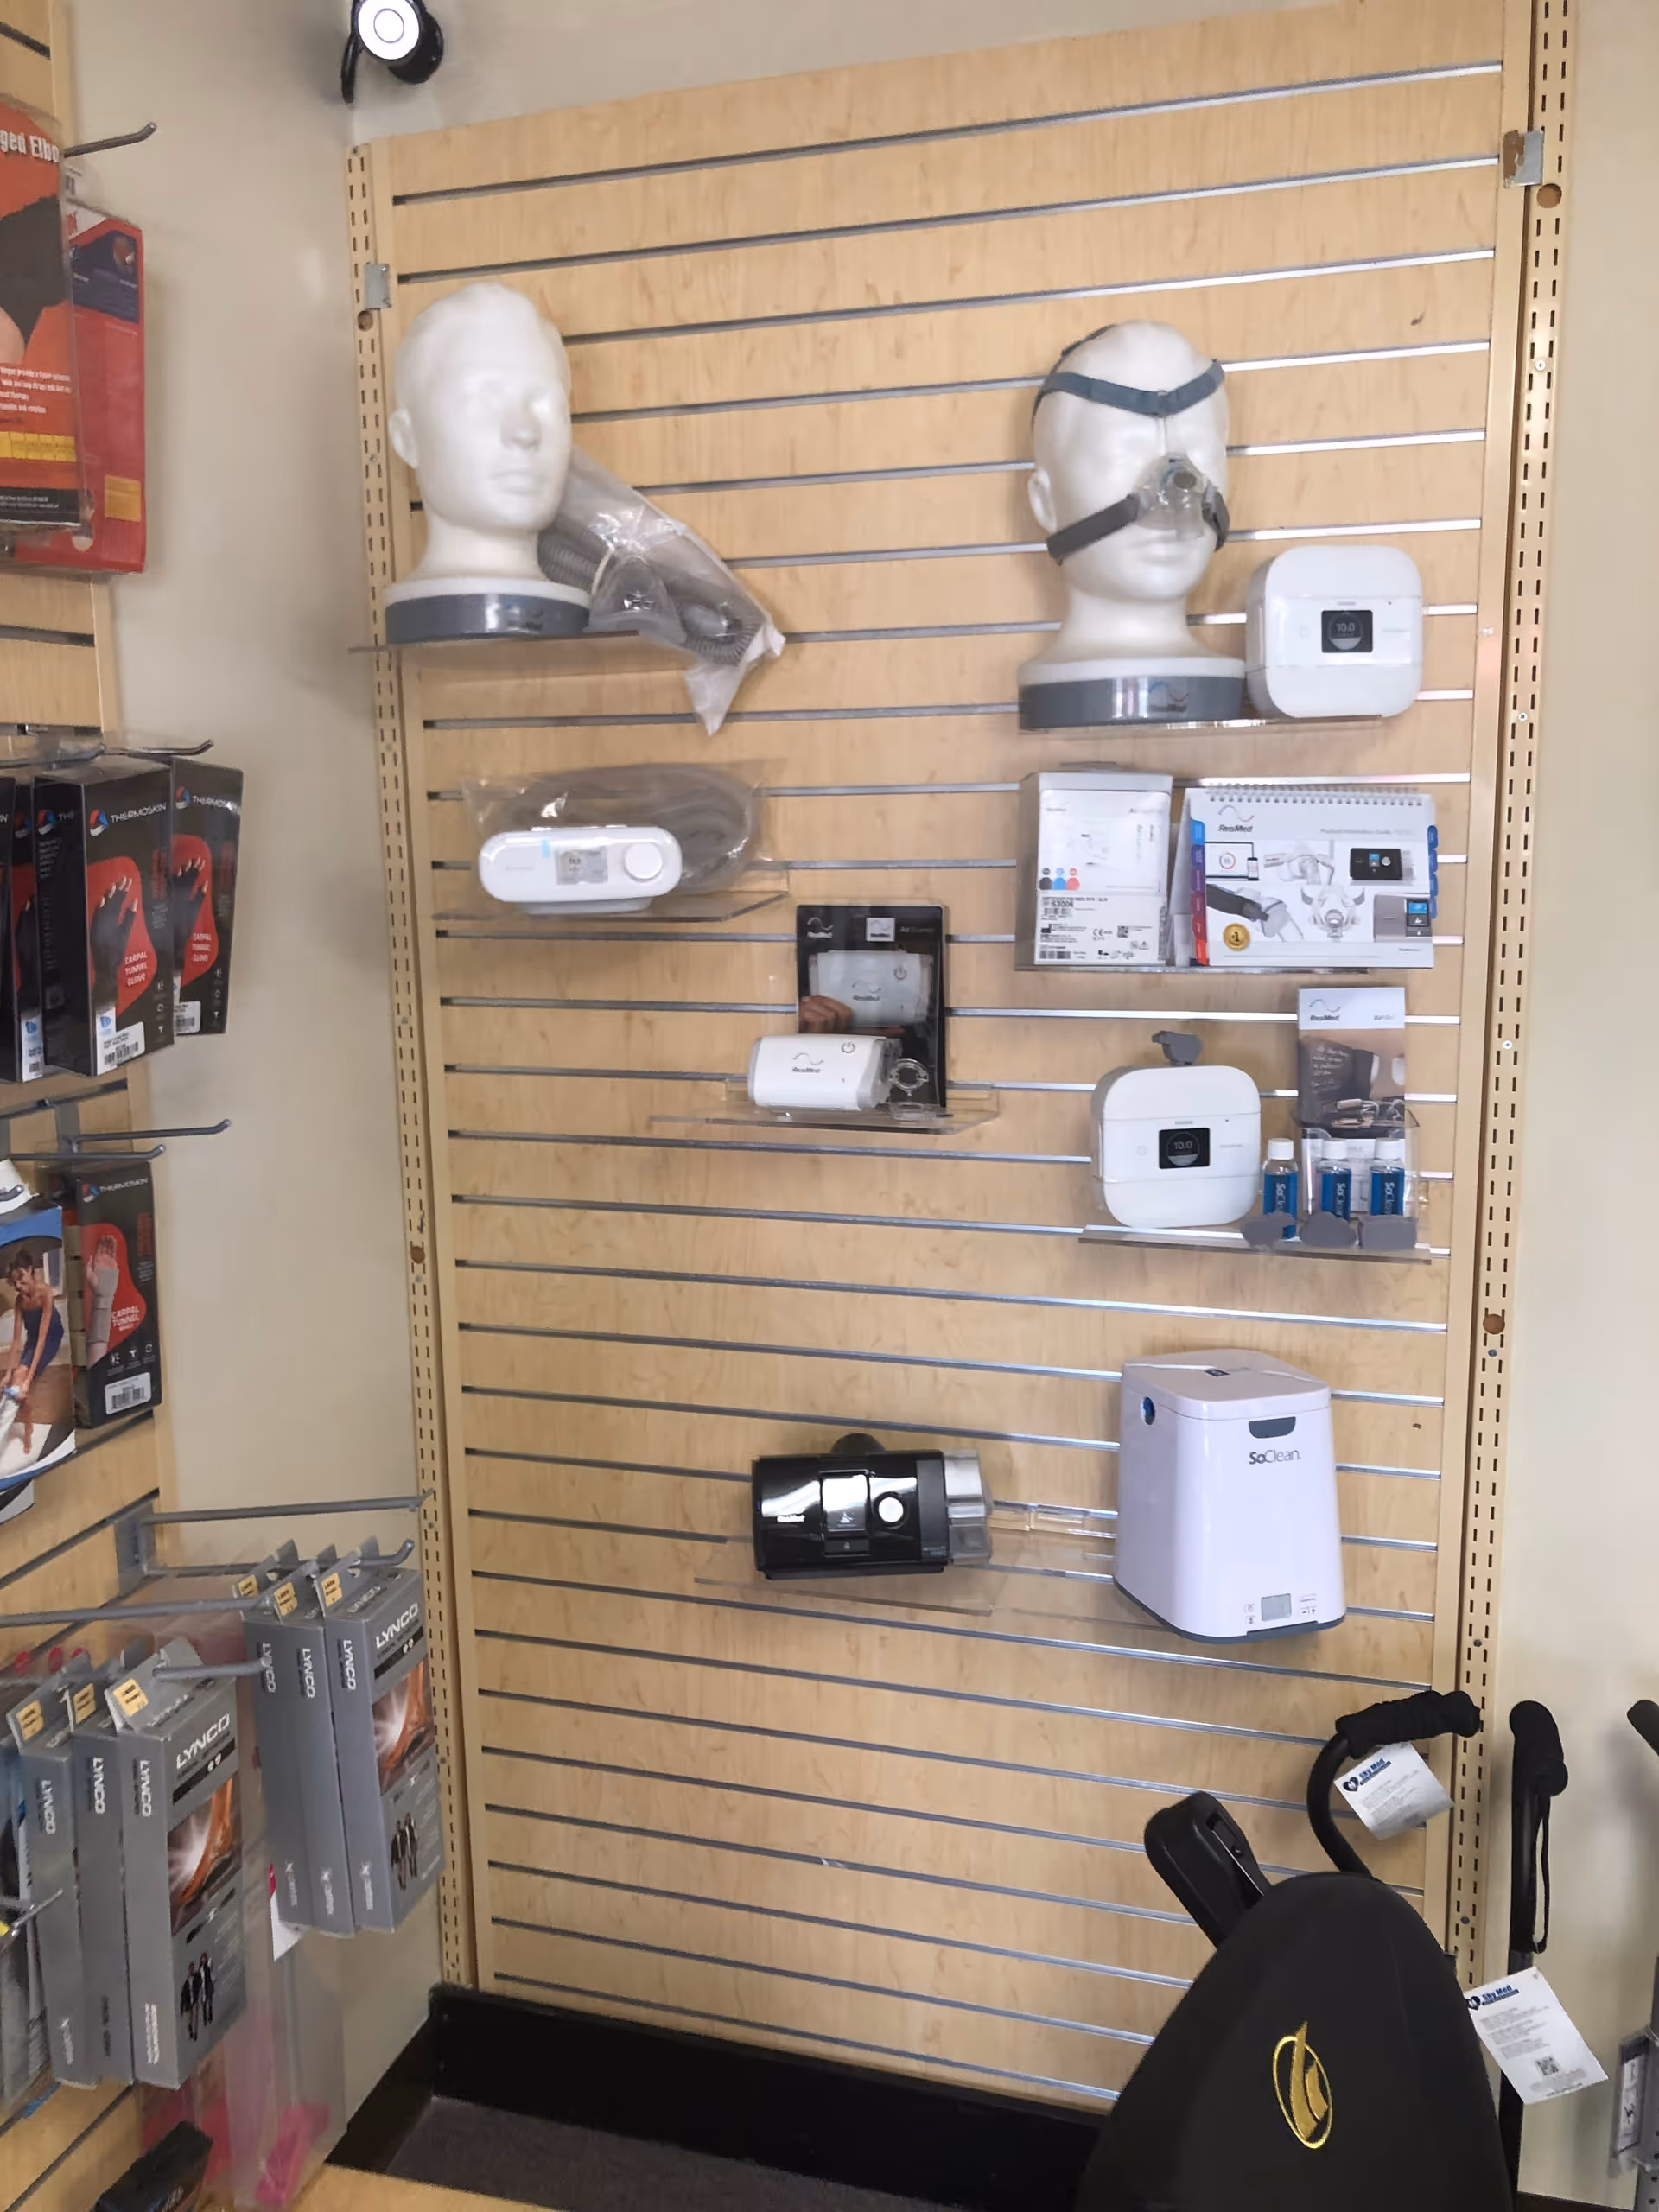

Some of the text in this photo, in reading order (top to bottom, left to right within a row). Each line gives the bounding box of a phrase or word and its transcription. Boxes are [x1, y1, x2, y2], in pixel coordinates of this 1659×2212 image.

[111, 803, 167, 823] THERMOSKIN
[125, 951, 148, 965] CARPAL
[125, 963, 148, 976] TUNNEL
[1174, 1140, 1193, 1150] 10.0
[99, 1177, 148, 1193] THERMOSKIN
[111, 1306, 140, 1319] CARPAL
[112, 1313, 140, 1327] TUNNEL
[1249, 1449, 1300, 1465] SoClean
[376, 1602, 418, 1649] LYNCO
[262, 1643, 276, 1693] LYCO
[302, 1648, 315, 1699] LYNCO
[343, 1639, 357, 1690] LYNCO
[176, 1713, 230, 1770] LYNCO
[92, 1757, 105, 1815] LYNCO
[139, 1759, 152, 1818] LYNCO
[41, 1780, 56, 1834] LYNCO
[1482, 1985, 1512, 2001] Sky Med
